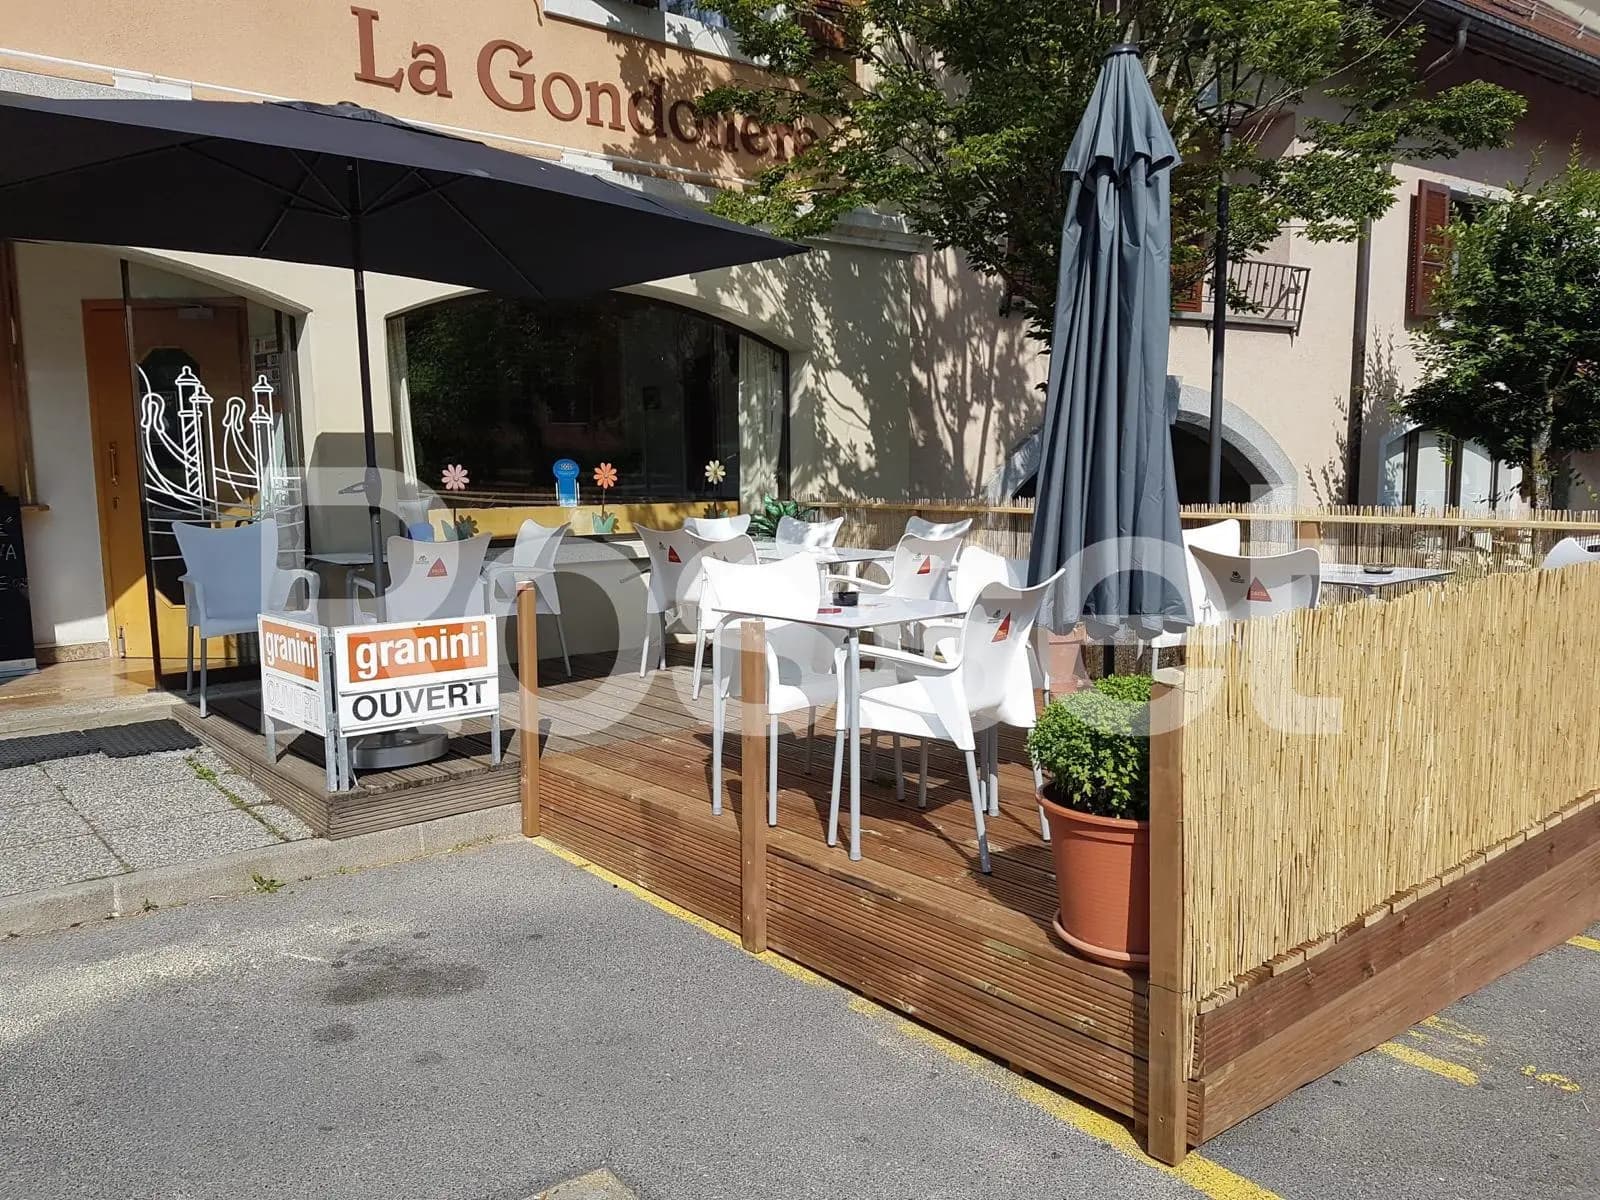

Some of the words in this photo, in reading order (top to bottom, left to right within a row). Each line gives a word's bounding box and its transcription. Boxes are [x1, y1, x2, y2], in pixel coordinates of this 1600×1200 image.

[350, 6, 453, 99] La
[264, 631, 317, 670] granini
[355, 625, 481, 681] granini
[352, 680, 488, 721] OUVERT
